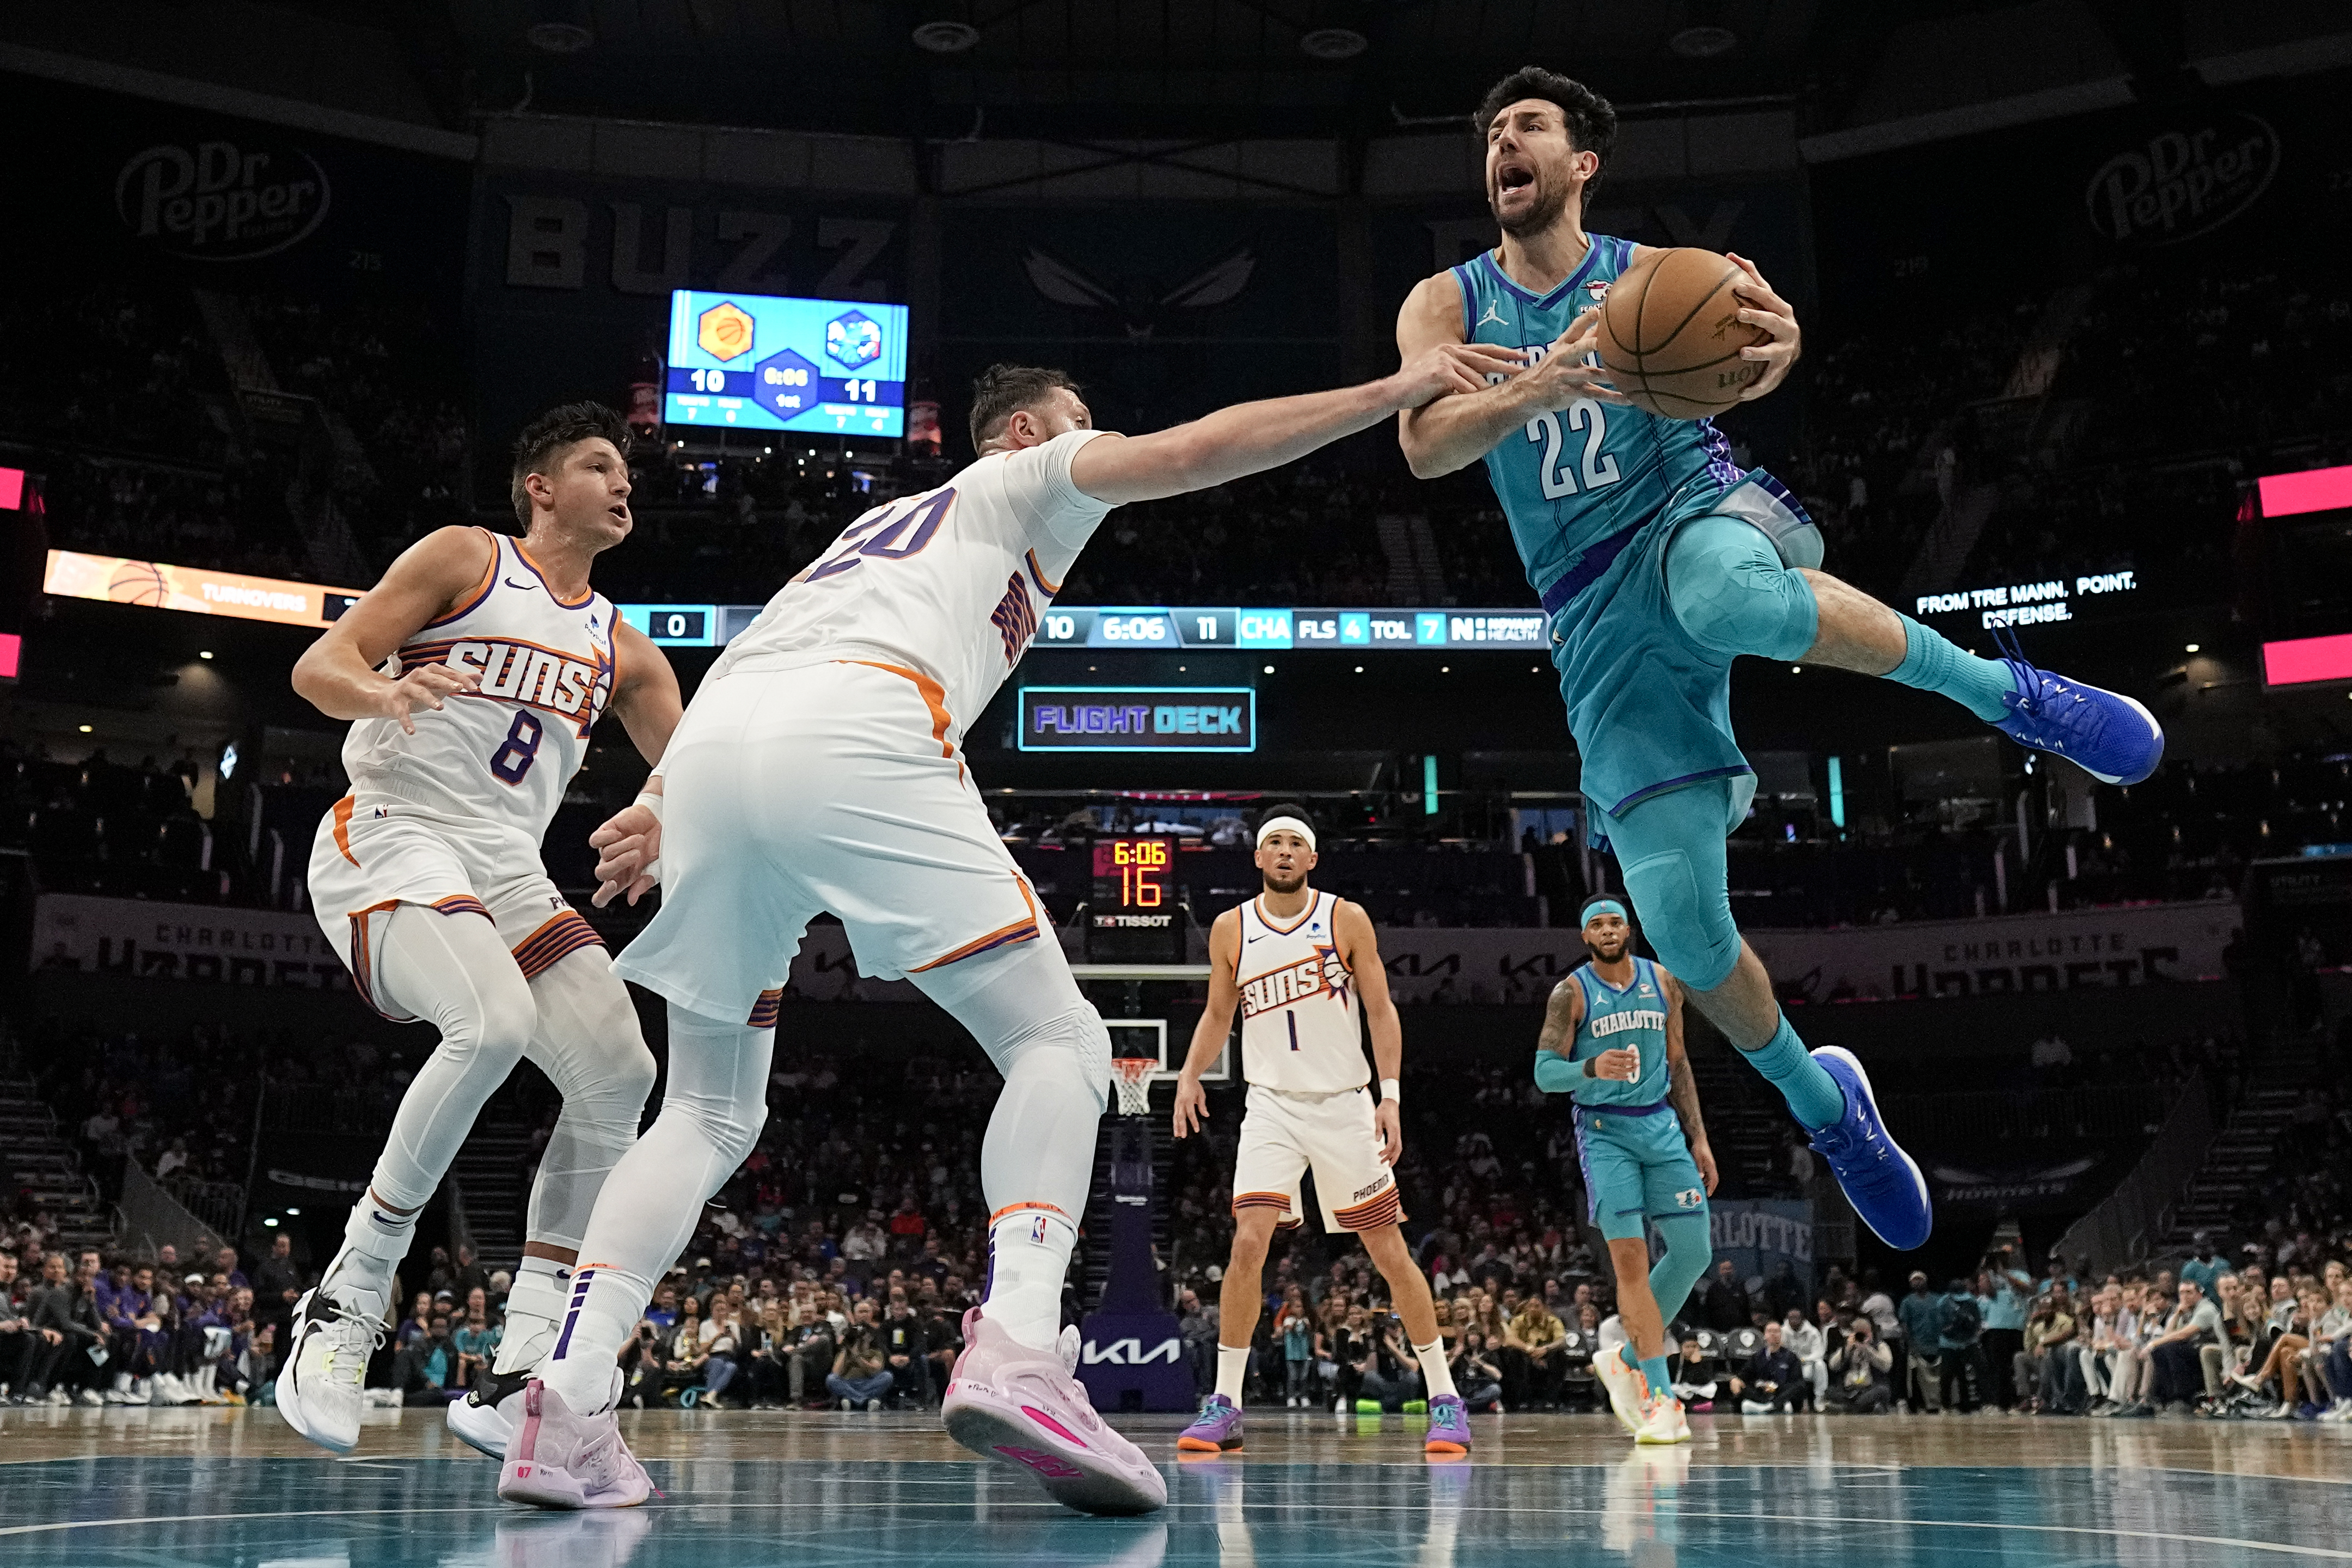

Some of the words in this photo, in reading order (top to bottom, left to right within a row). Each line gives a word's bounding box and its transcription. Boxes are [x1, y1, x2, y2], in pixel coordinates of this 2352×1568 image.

[194, 140, 271, 194] Dr
[2150, 127, 2216, 184] Dr
[136, 144, 315, 245] Pepper
[2106, 136, 2265, 241] Pepper
[501, 194, 899, 301] BUZZ
[690, 368, 725, 393] 10
[844, 378, 876, 402] 11
[1525, 397, 1622, 501] 22
[201, 583, 307, 612] TURNOVERS
[1917, 591, 1969, 614] FROM
[1970, 587, 2008, 608] TRE
[584, 623, 607, 646] PayPal
[667, 614, 686, 637] 0
[1045, 616, 1075, 639] 10
[1103, 617, 1166, 641] 6:06
[1196, 616, 1217, 640] 11
[1240, 617, 1291, 639] CHA
[1298, 620, 1337, 639] FLS
[1344, 620, 1362, 639] 4
[1370, 620, 1412, 640] TOL
[1423, 620, 1439, 639] 7
[1487, 617, 1543, 630] NOVANT
[1487, 629, 1539, 641] HEALTH
[445, 642, 592, 714] SUNS
[1034, 705, 1149, 734] FLIGHT
[1153, 705, 1242, 734] DECK
[490, 708, 543, 787] 8
[1114, 842, 1166, 865] 6:06
[1123, 866, 1161, 906] 16
[1115, 915, 1172, 927] TISSOT
[1944, 933, 2126, 963] CHARLOTTE
[1243, 960, 1321, 1016] SUNS
[1286, 1010, 1301, 1051] 1
[1591, 1009, 1666, 1039] CHARLOTTE
[1082, 1337, 1181, 1364] KIA
[517, 1466, 532, 1478] 07
